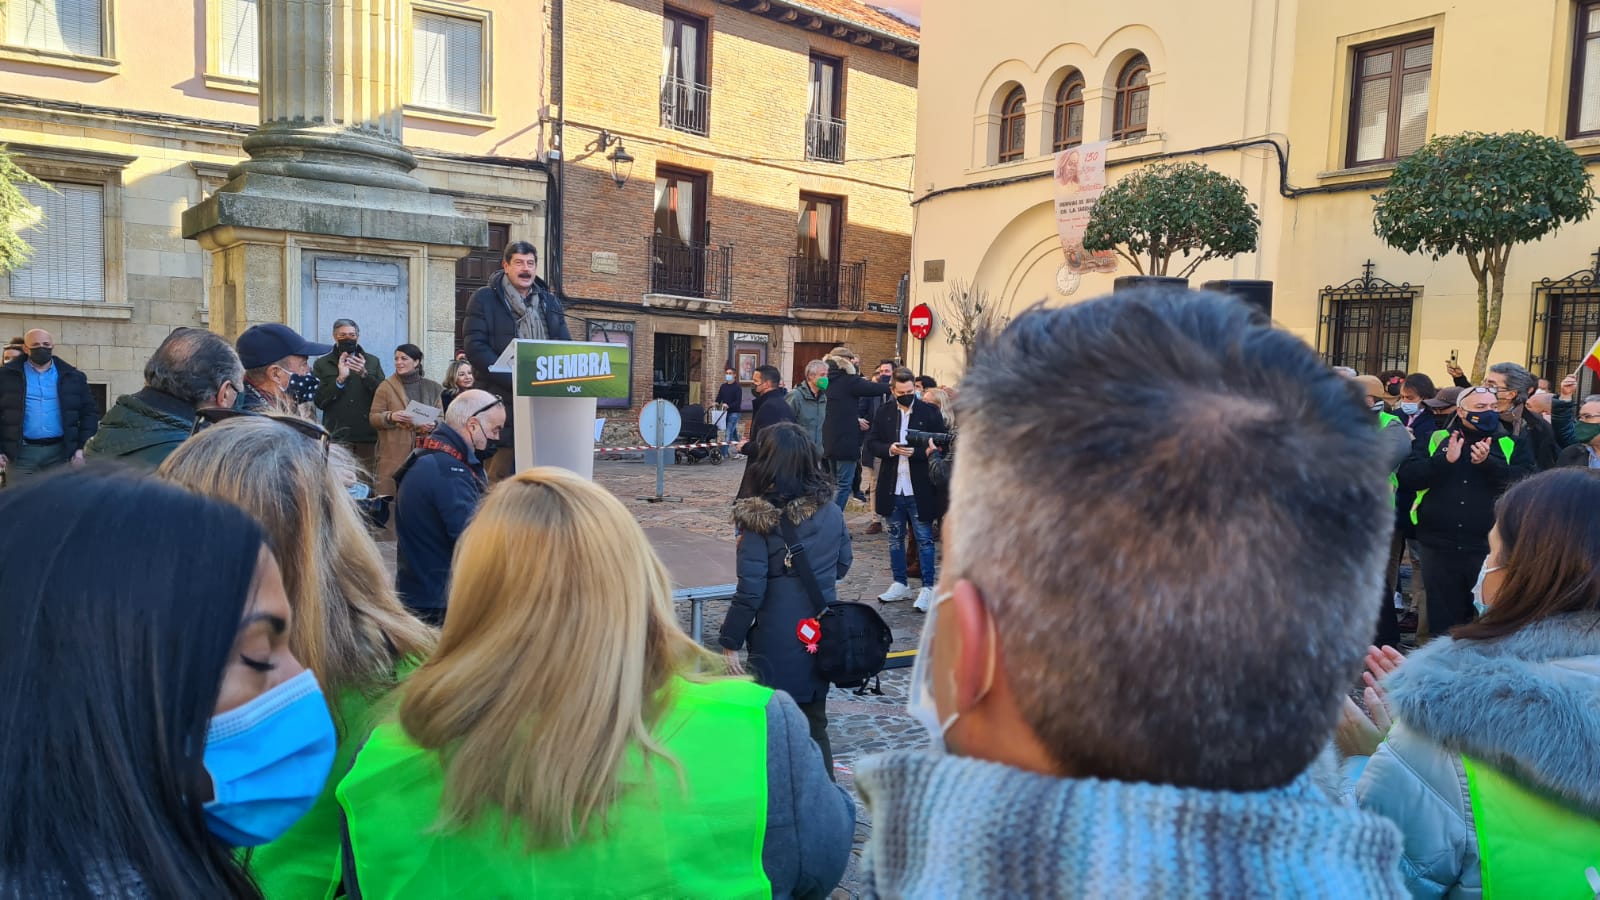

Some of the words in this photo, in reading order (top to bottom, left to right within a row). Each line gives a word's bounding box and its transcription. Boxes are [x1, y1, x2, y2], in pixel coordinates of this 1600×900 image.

[612, 322, 632, 331] Foto
[536, 352, 611, 381] SIEMBRA
[566, 385, 581, 393] VOX
